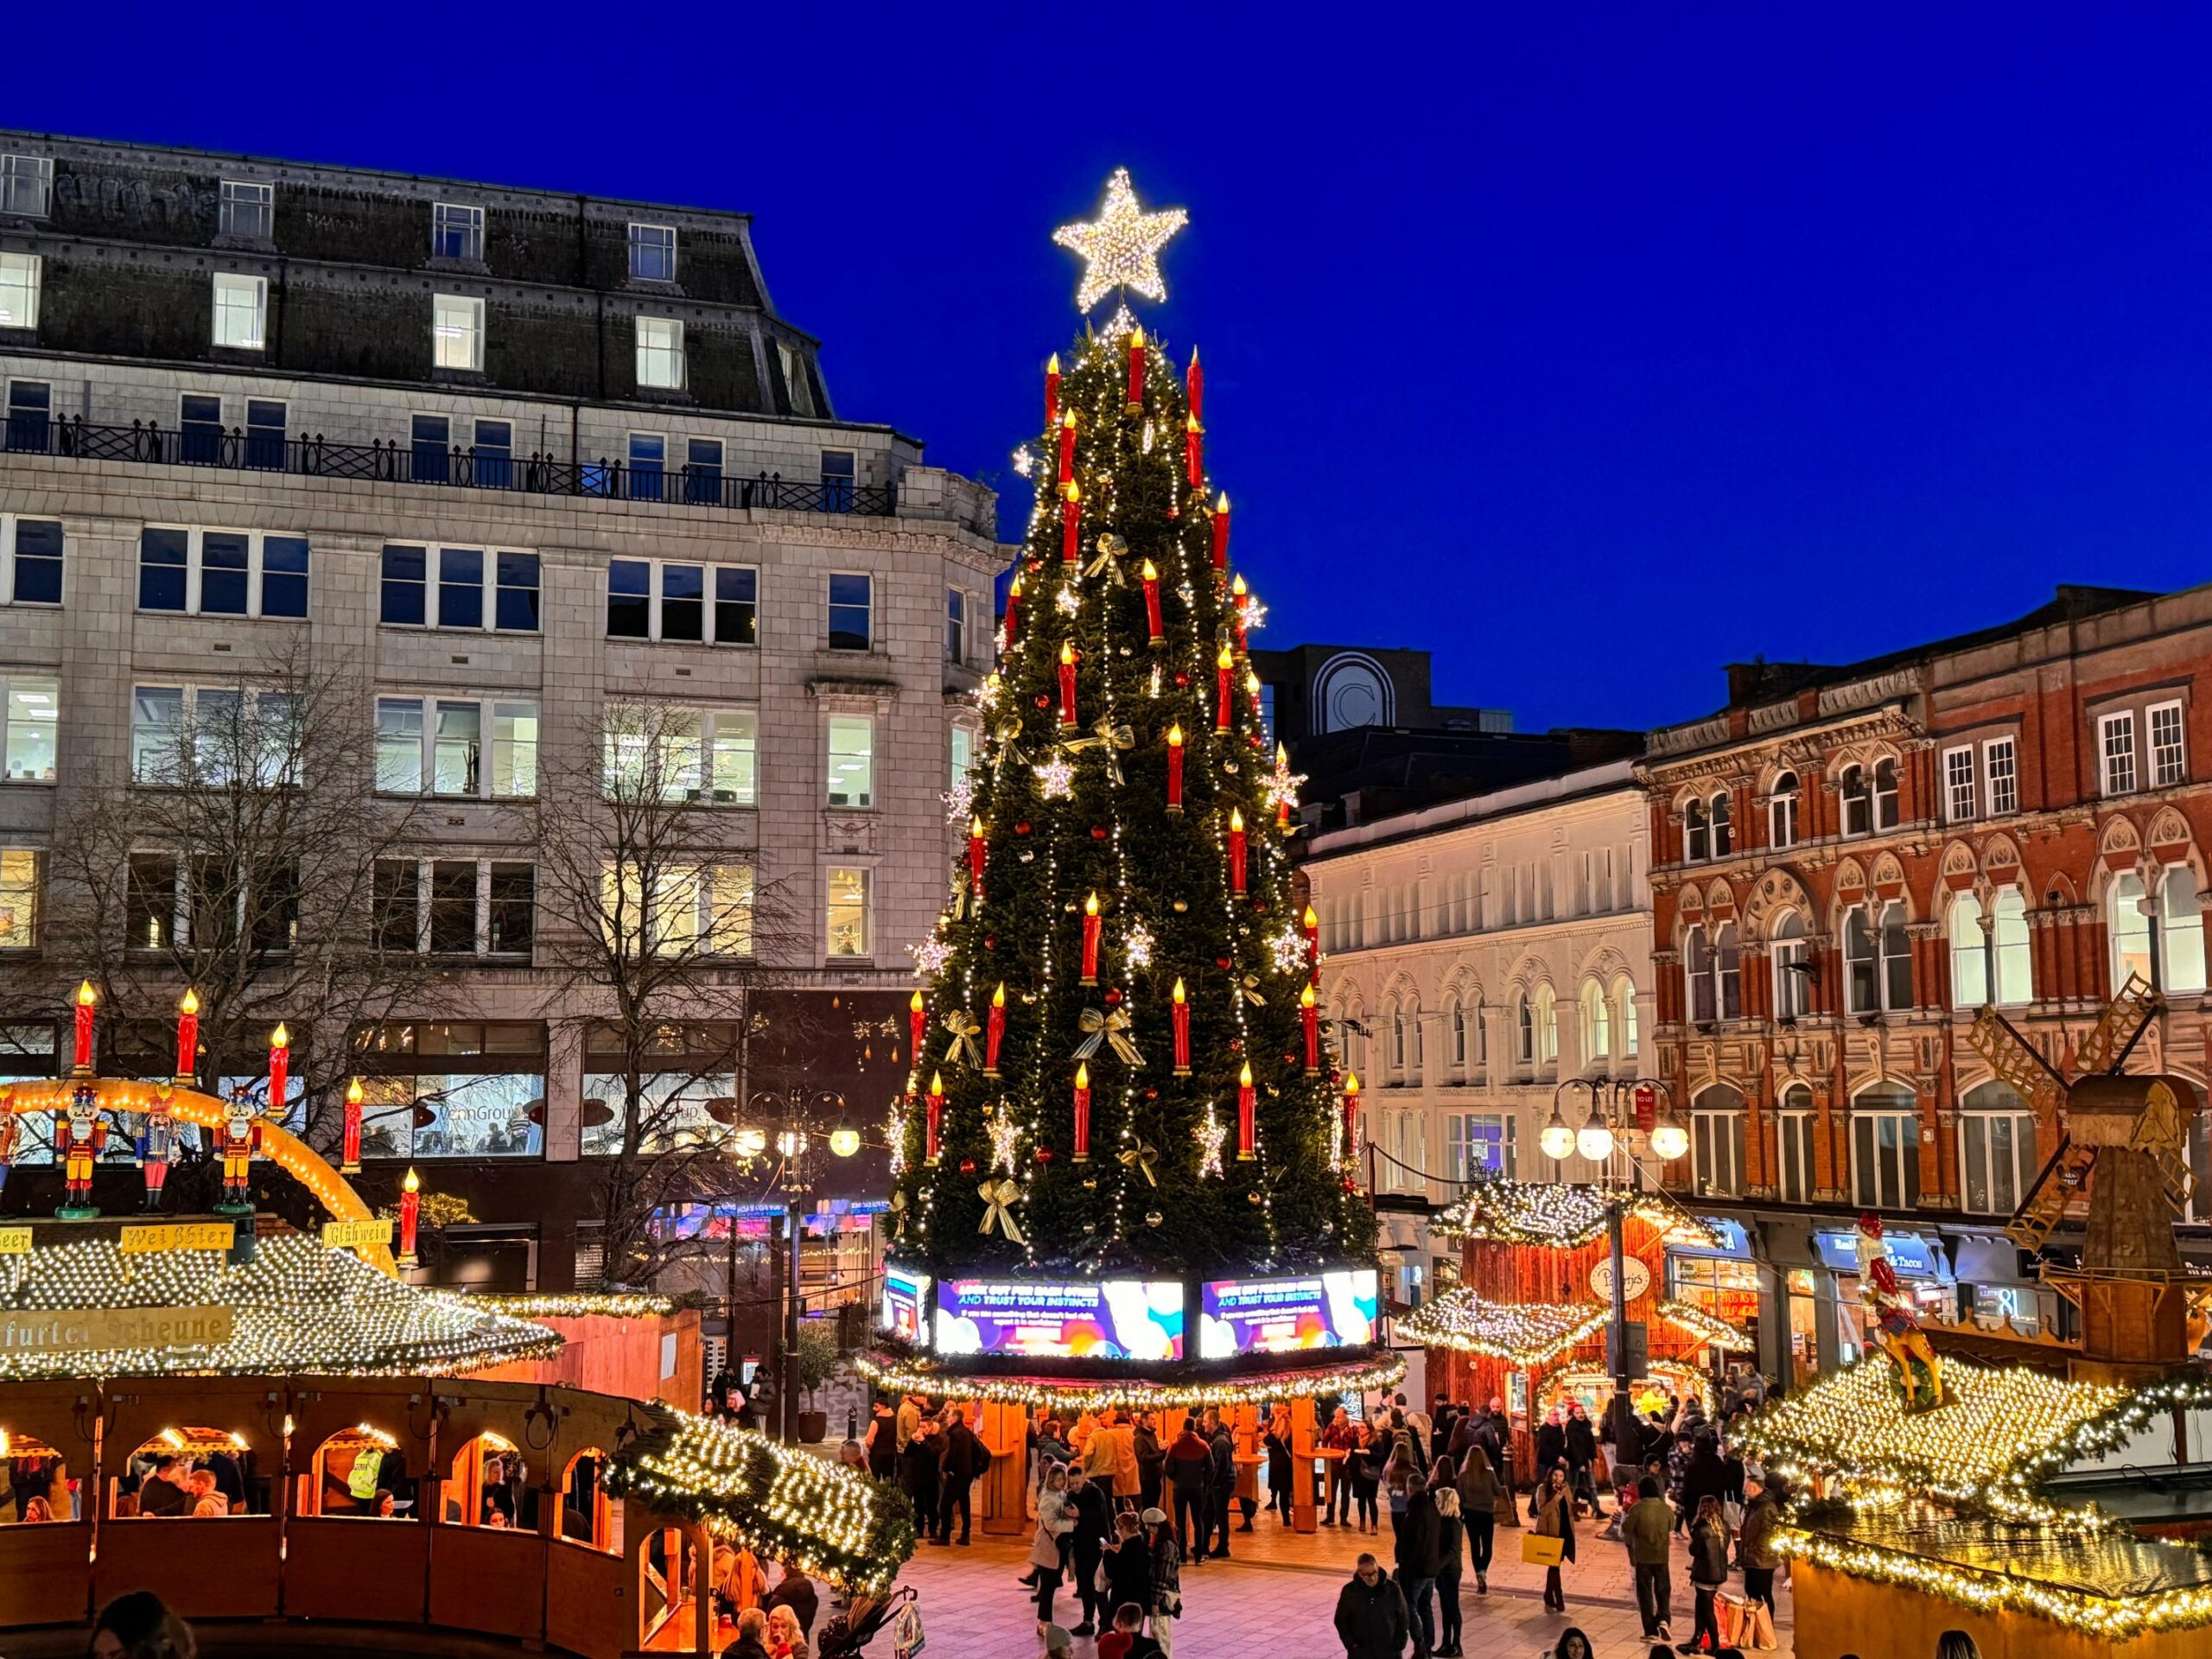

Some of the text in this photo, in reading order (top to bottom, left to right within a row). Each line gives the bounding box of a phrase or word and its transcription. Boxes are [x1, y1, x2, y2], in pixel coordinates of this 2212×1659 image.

[331, 1223, 387, 1244] Glühwein
[958, 1295, 1099, 1307] AND TRUST YOUR INSTINCTS
[107, 1316, 223, 1343] Scheune
